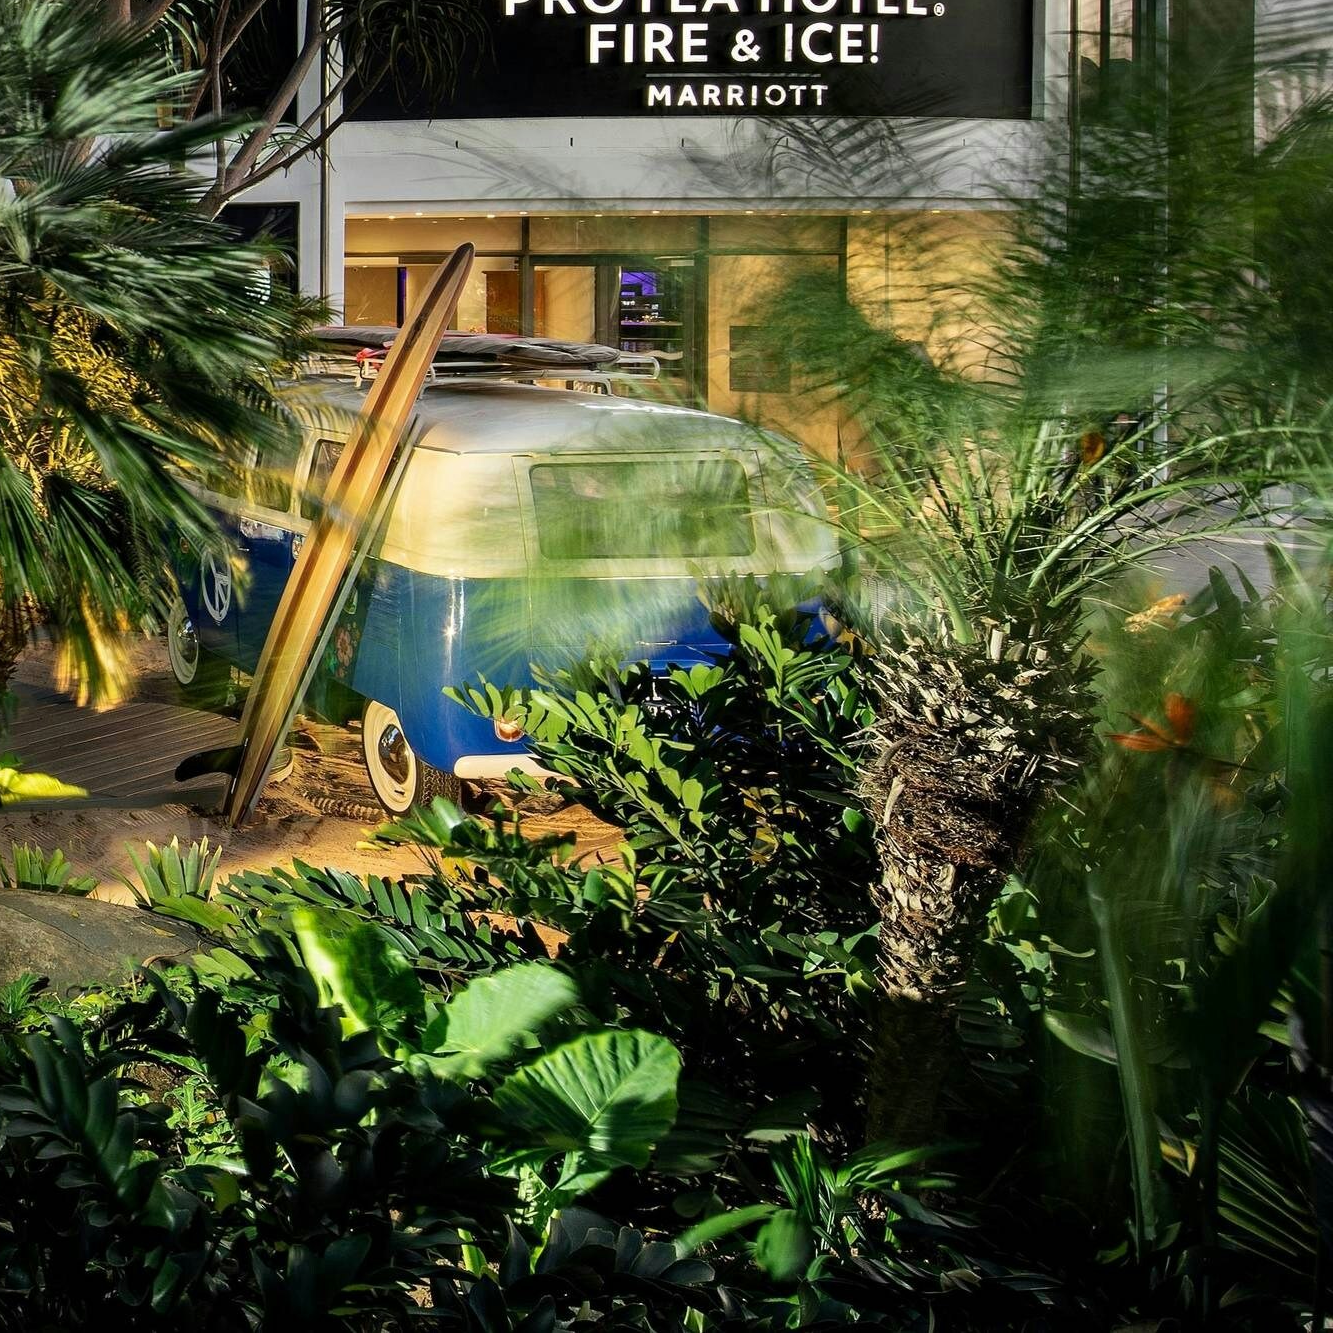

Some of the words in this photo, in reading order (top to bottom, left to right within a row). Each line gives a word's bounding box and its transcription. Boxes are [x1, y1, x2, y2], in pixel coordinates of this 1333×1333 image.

[589, 22, 710, 64] FIRE
[730, 28, 762, 63] &
[783, 21, 880, 65] ICE!
[646, 84, 829, 107] MARRIOTT
